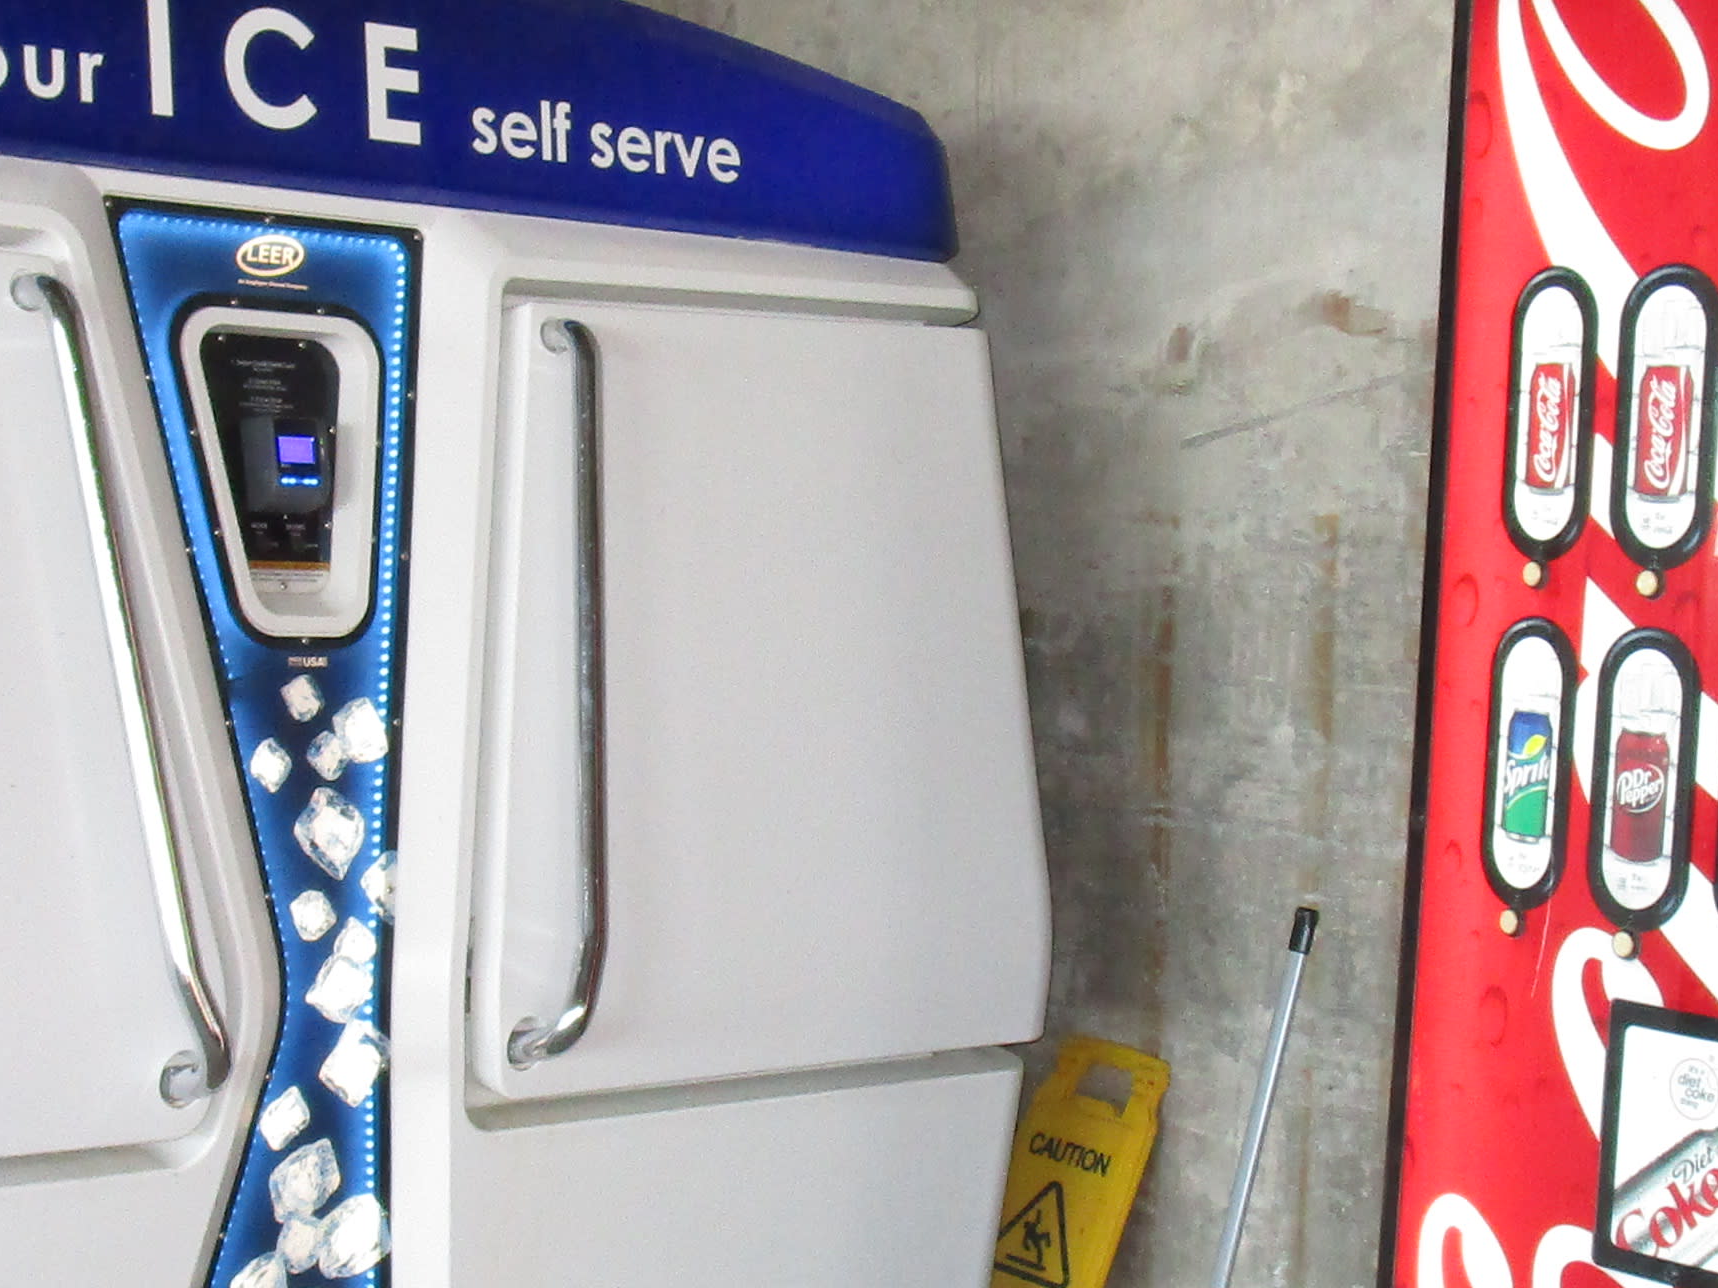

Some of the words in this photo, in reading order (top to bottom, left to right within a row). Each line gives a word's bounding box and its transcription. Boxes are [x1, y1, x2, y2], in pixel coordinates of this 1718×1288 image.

[471, 99, 574, 164] self
[590, 121, 742, 184] serve
[246, 244, 295, 266] LEER
[1533, 371, 1562, 483] Coca-Cola
[1643, 373, 1677, 490] Coca-Cola
[1618, 770, 1663, 807] Pepper
[1635, 768, 1653, 785] Dr
[1029, 1131, 1111, 1177] CAUTION
[1671, 1145, 1716, 1185] Diet
